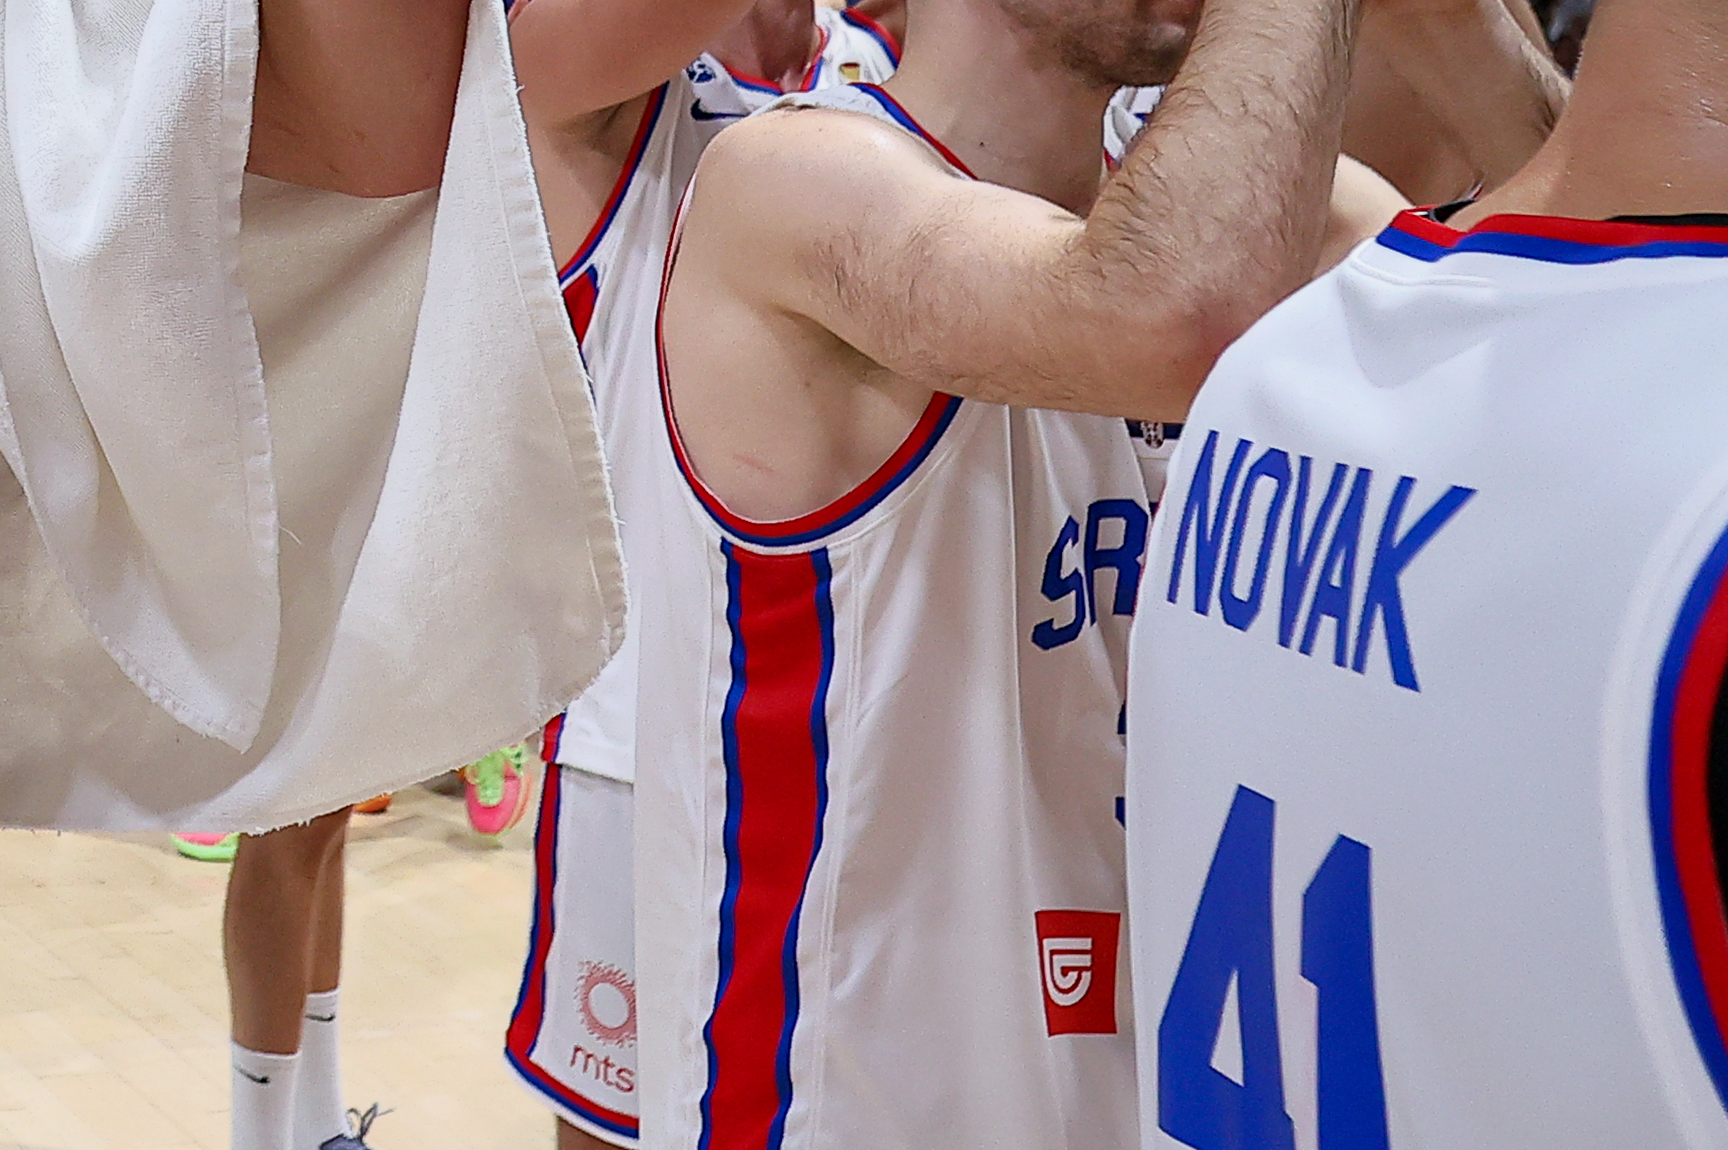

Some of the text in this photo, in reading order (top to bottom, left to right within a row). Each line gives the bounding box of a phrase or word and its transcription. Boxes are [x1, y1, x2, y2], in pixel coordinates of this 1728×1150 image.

[1166, 429, 1479, 693] NOVAK
[570, 1044, 636, 1093] mts
[1157, 783, 1391, 1150] 41
